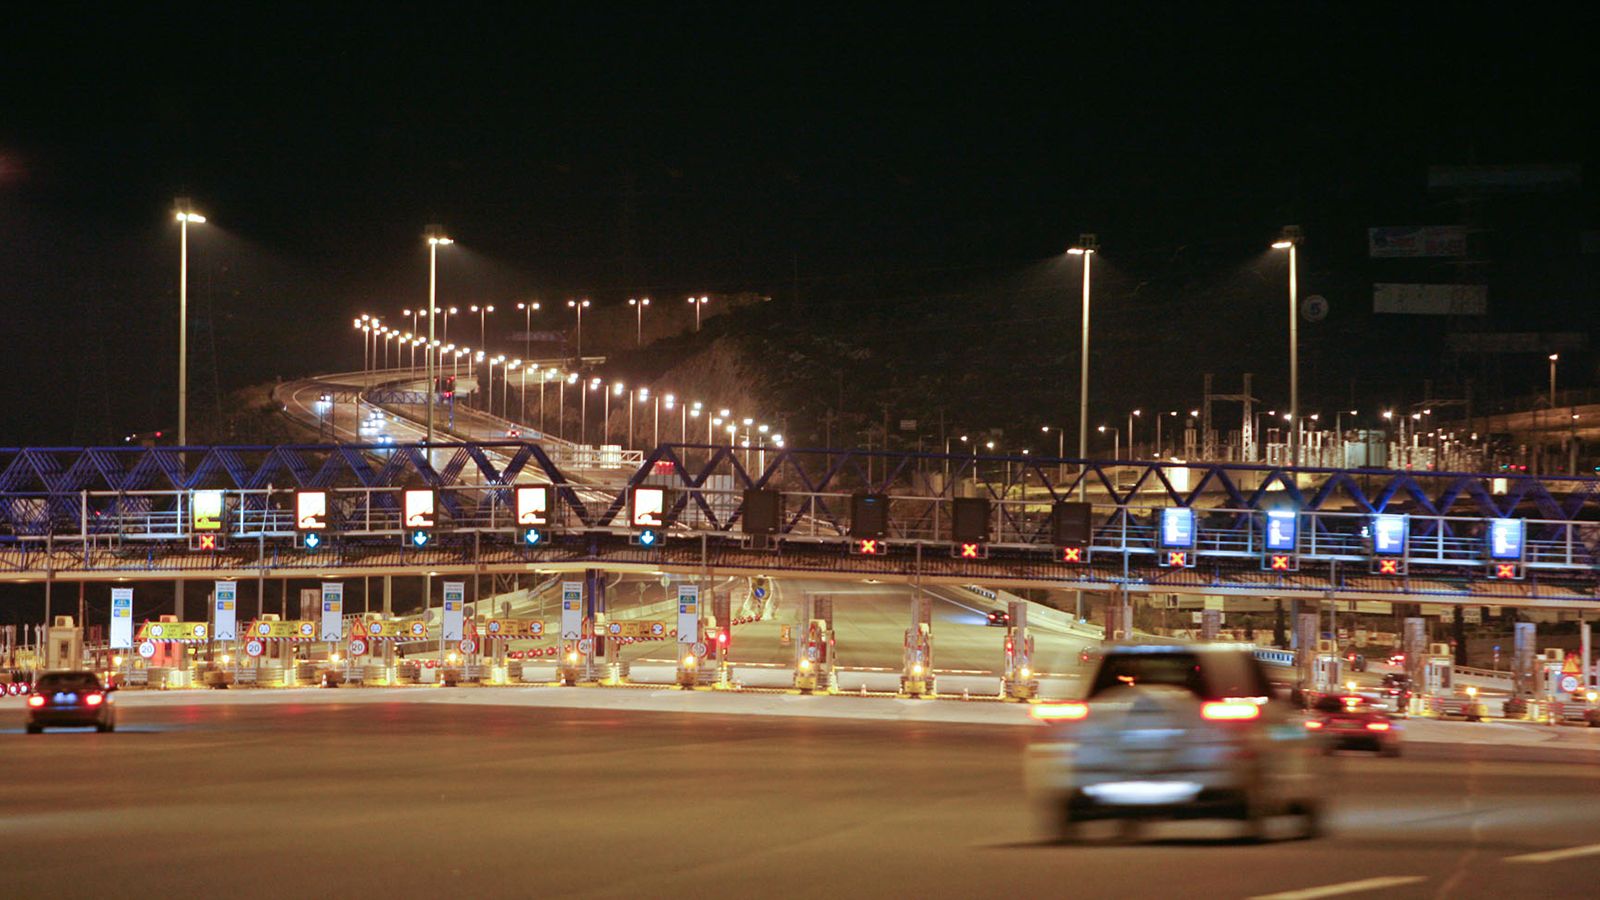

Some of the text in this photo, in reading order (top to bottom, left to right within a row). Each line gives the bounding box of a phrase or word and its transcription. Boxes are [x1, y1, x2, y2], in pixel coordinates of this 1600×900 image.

[141, 645, 154, 653] 20
[248, 644, 260, 652] 20
[351, 643, 363, 651] 20
